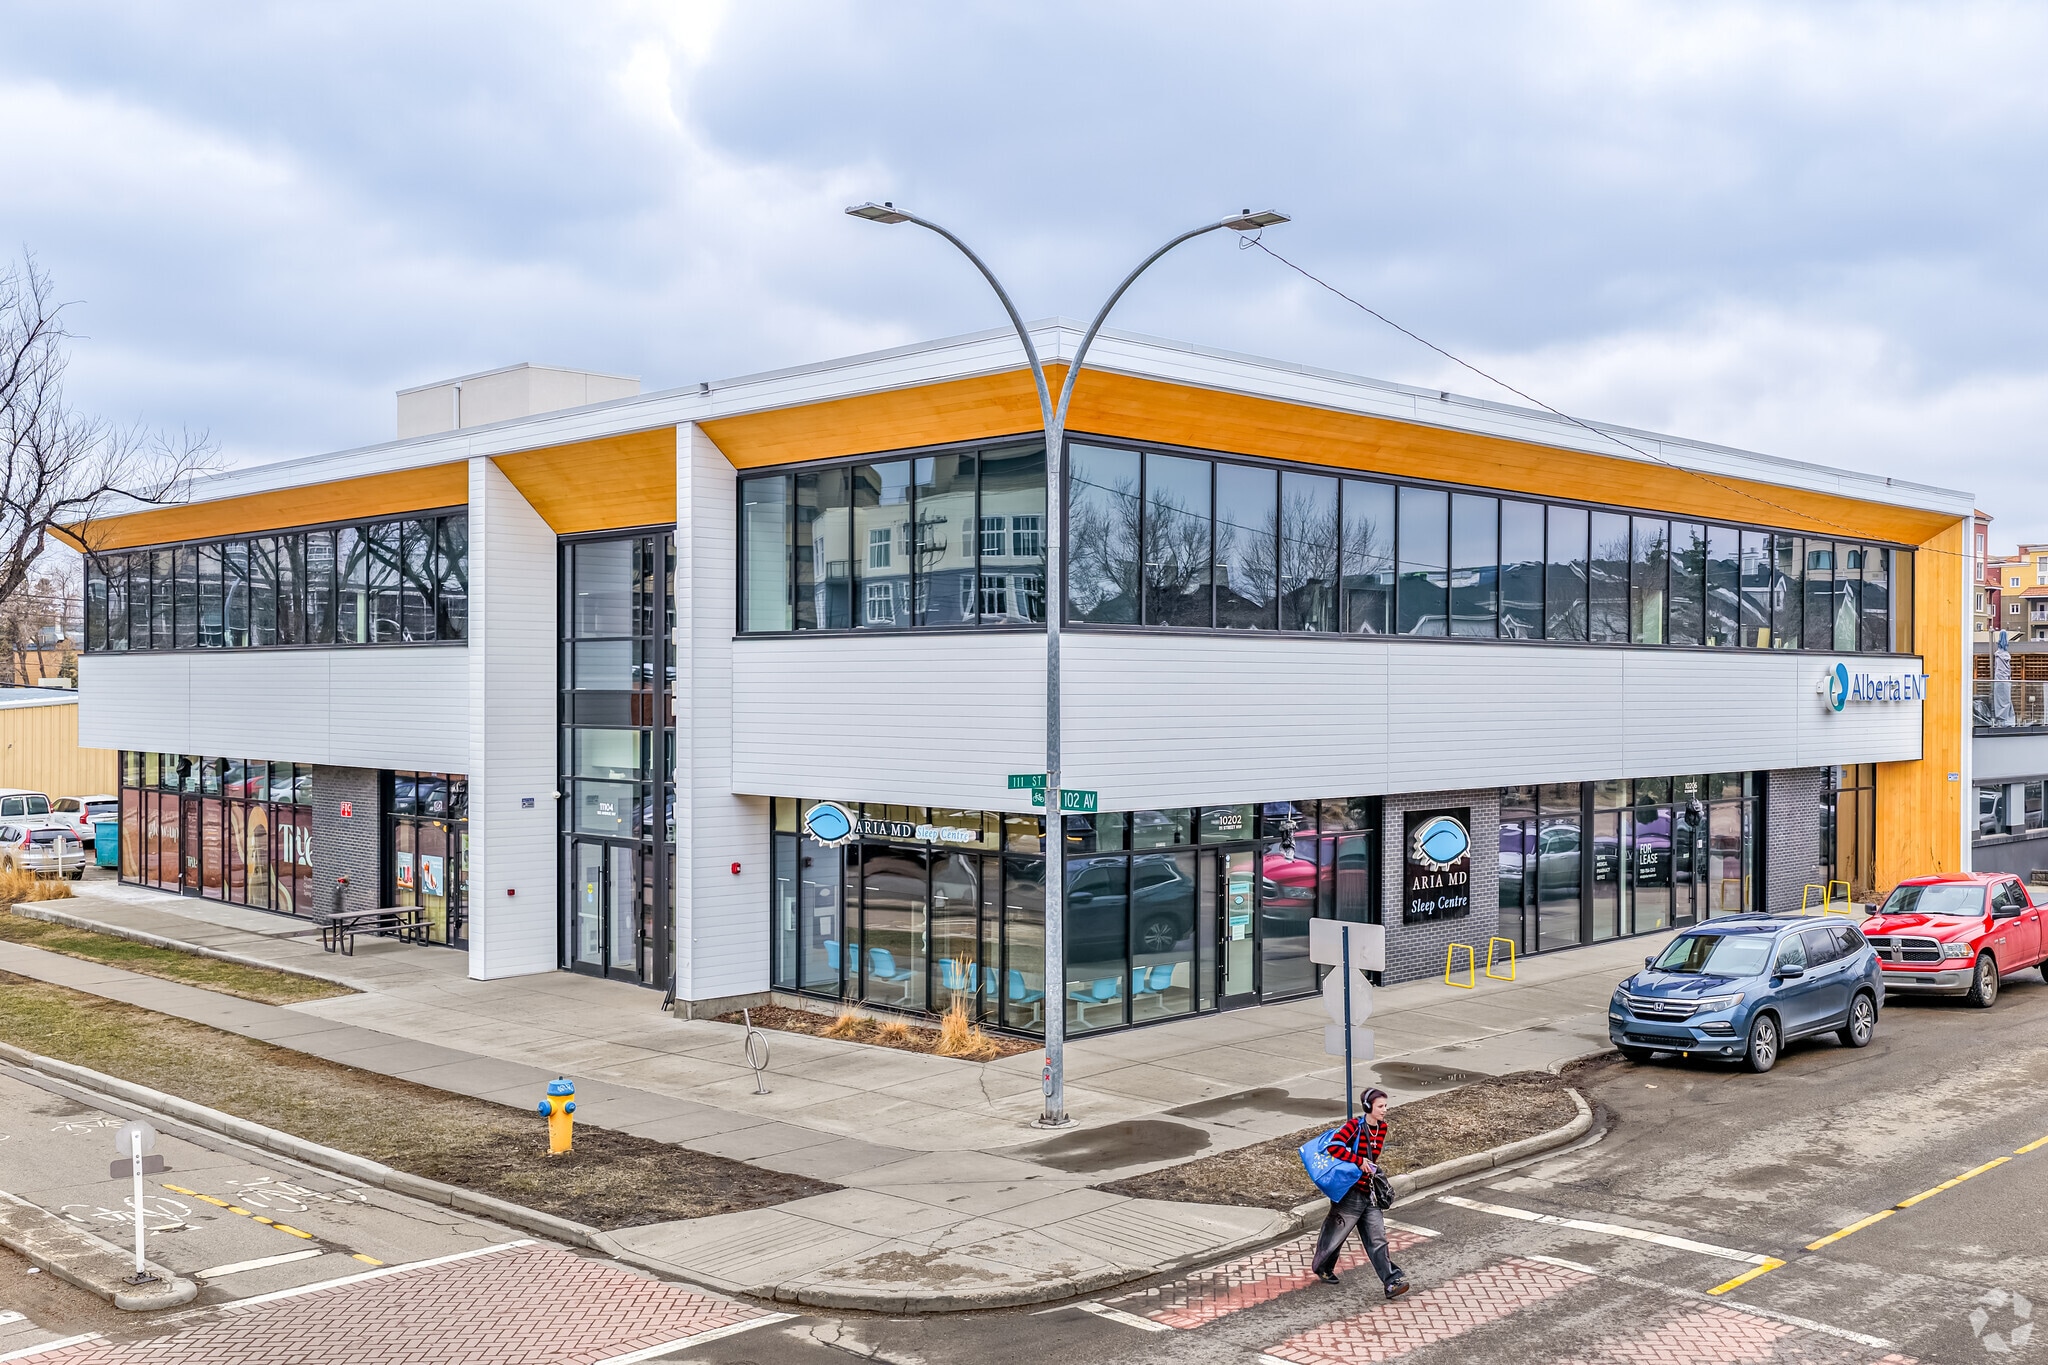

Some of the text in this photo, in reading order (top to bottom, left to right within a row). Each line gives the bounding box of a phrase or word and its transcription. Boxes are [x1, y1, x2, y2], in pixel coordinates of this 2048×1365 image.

[1851, 673, 1930, 701] Alberta ENT
[1013, 775, 1042, 787] 111 ST
[1064, 792, 1095, 808] 102 AV
[1219, 815, 1242, 825] 10202
[855, 820, 970, 841] ARIA MD Sleep Centre
[1639, 843, 1652, 854] FOR
[1639, 853, 1658, 865] LEASE
[1412, 871, 1467, 891] ARIA MD
[1411, 895, 1468, 915] Sleep Centre
